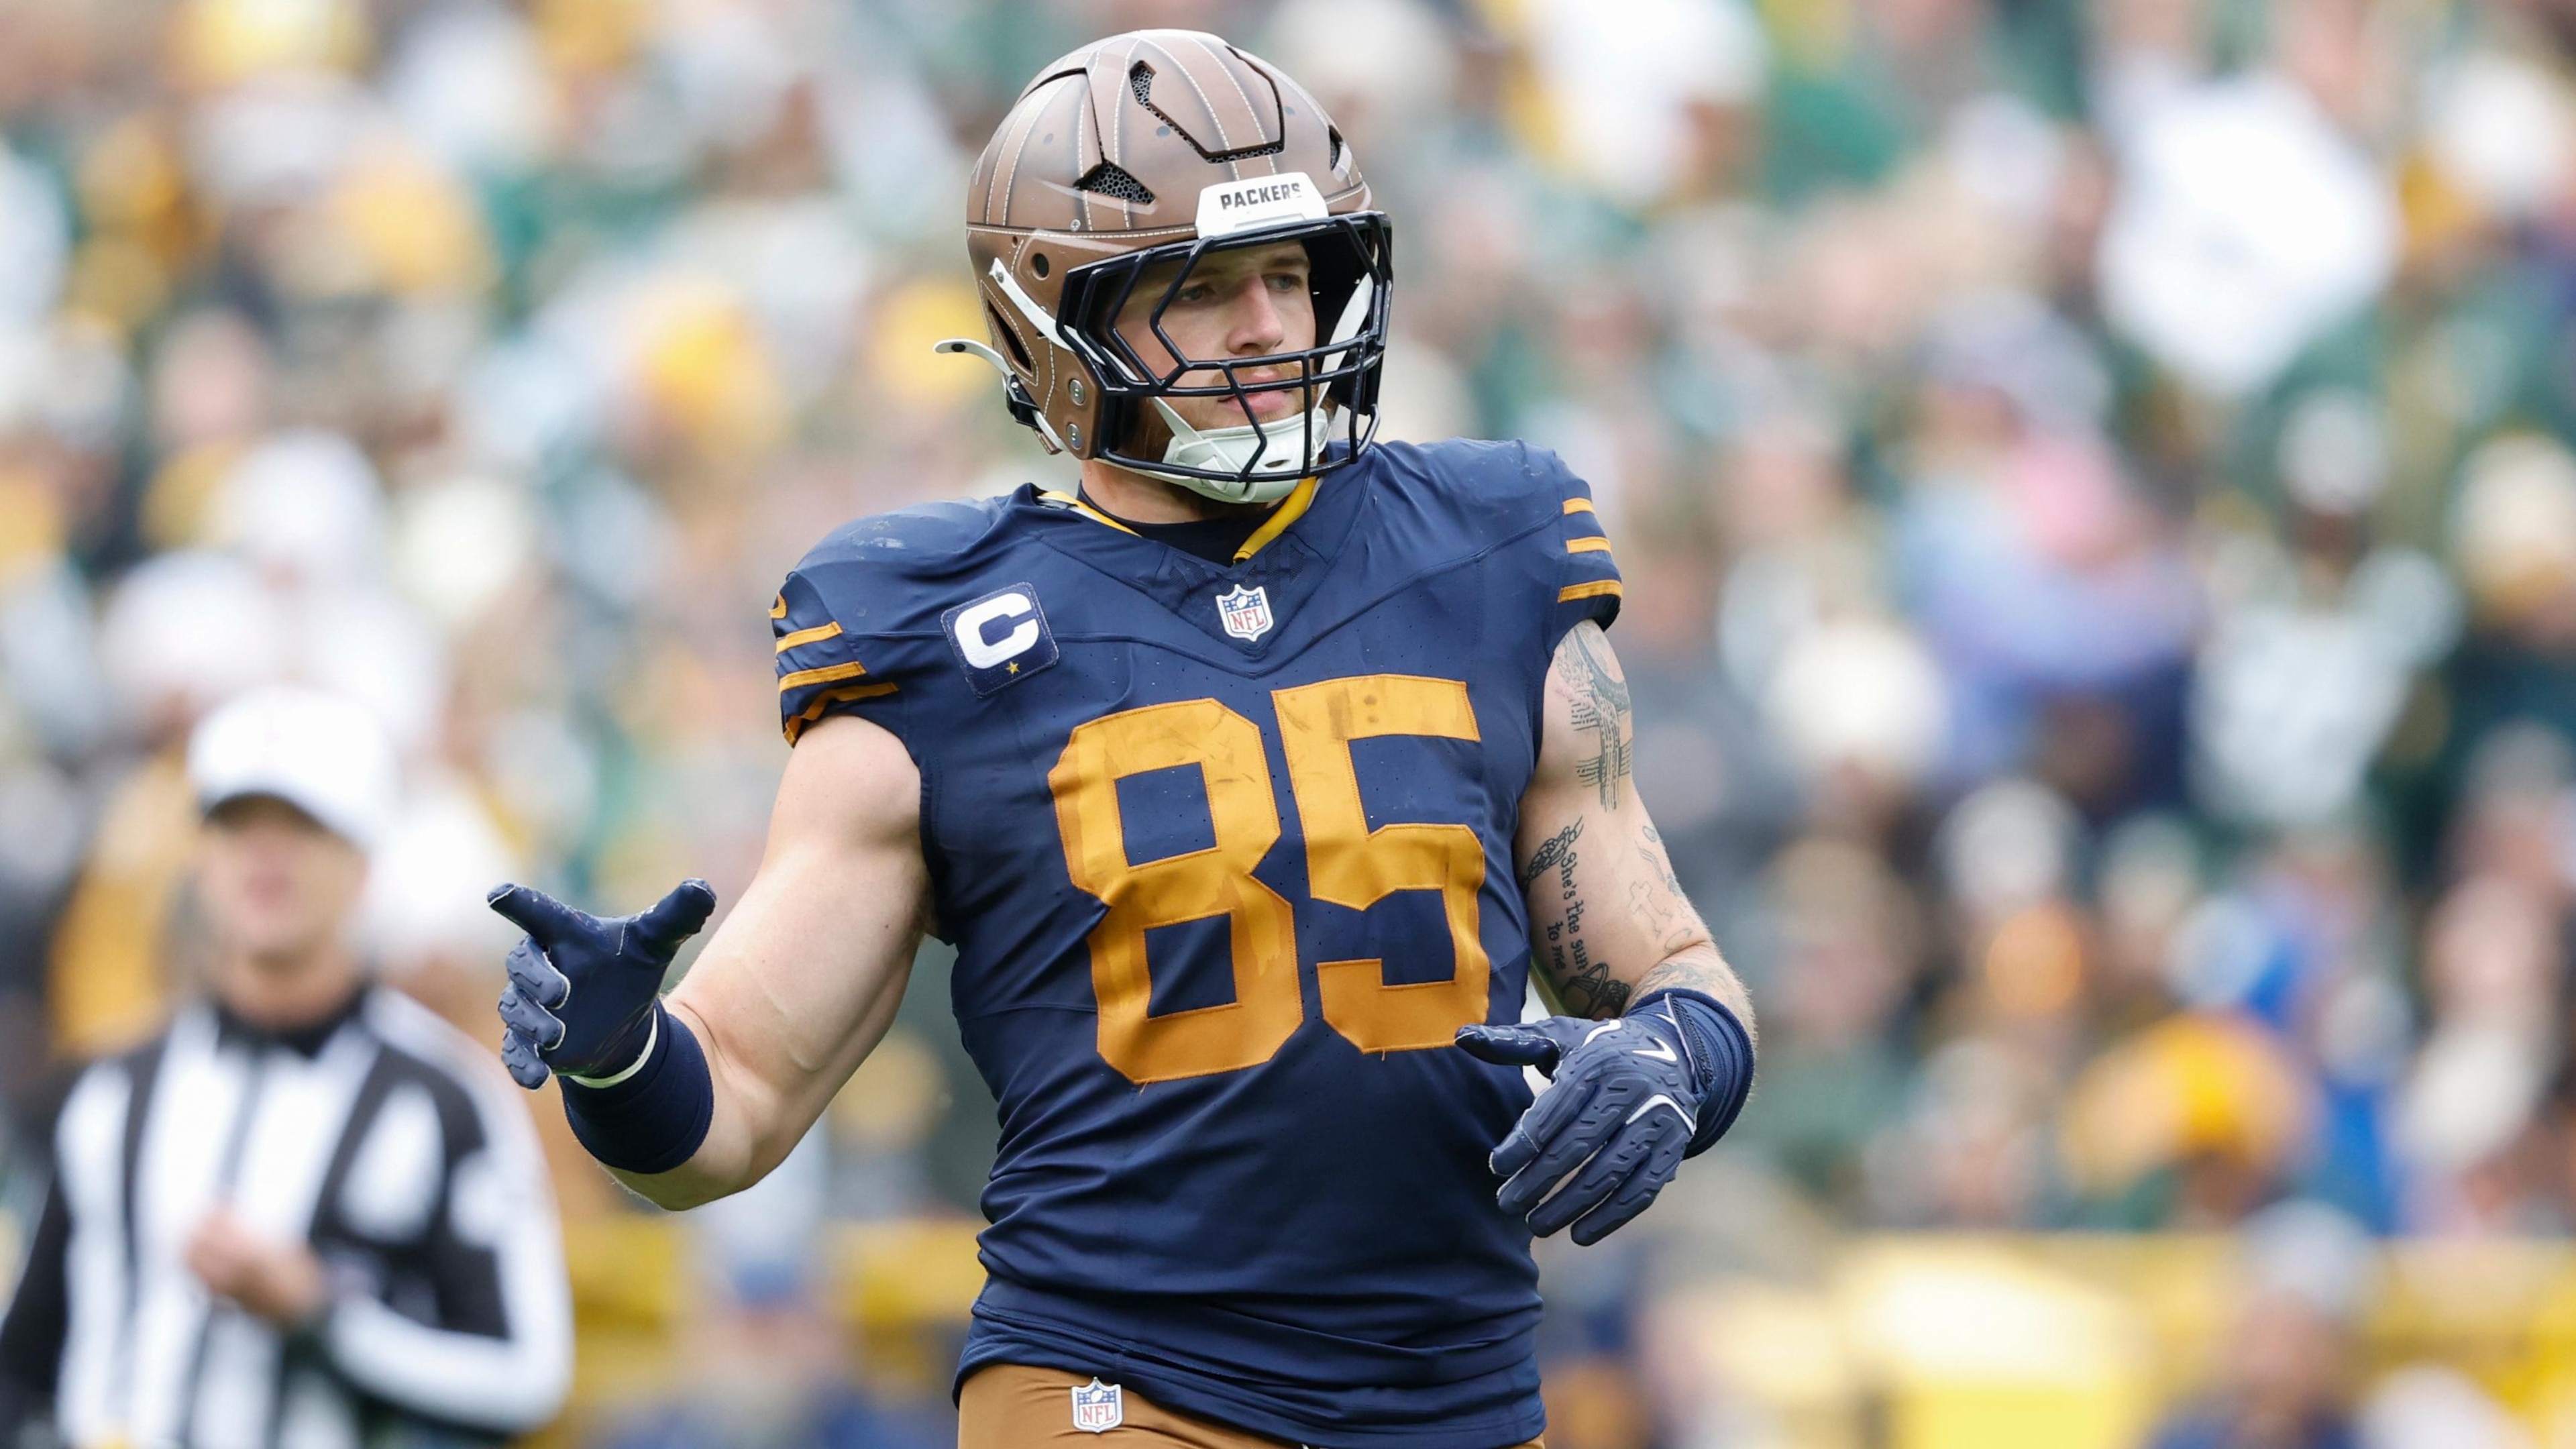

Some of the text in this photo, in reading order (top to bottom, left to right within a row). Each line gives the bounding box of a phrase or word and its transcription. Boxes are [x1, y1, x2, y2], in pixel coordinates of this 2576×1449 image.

[1220, 182, 1302, 210] PACKERS
[954, 592, 1040, 669] C
[1230, 608, 1265, 631] NFL
[1047, 673, 1490, 1085] 85
[1561, 852, 1589, 971] She's the sun
[1547, 920, 1567, 971] to me
[1081, 1404, 1114, 1425] NFL
